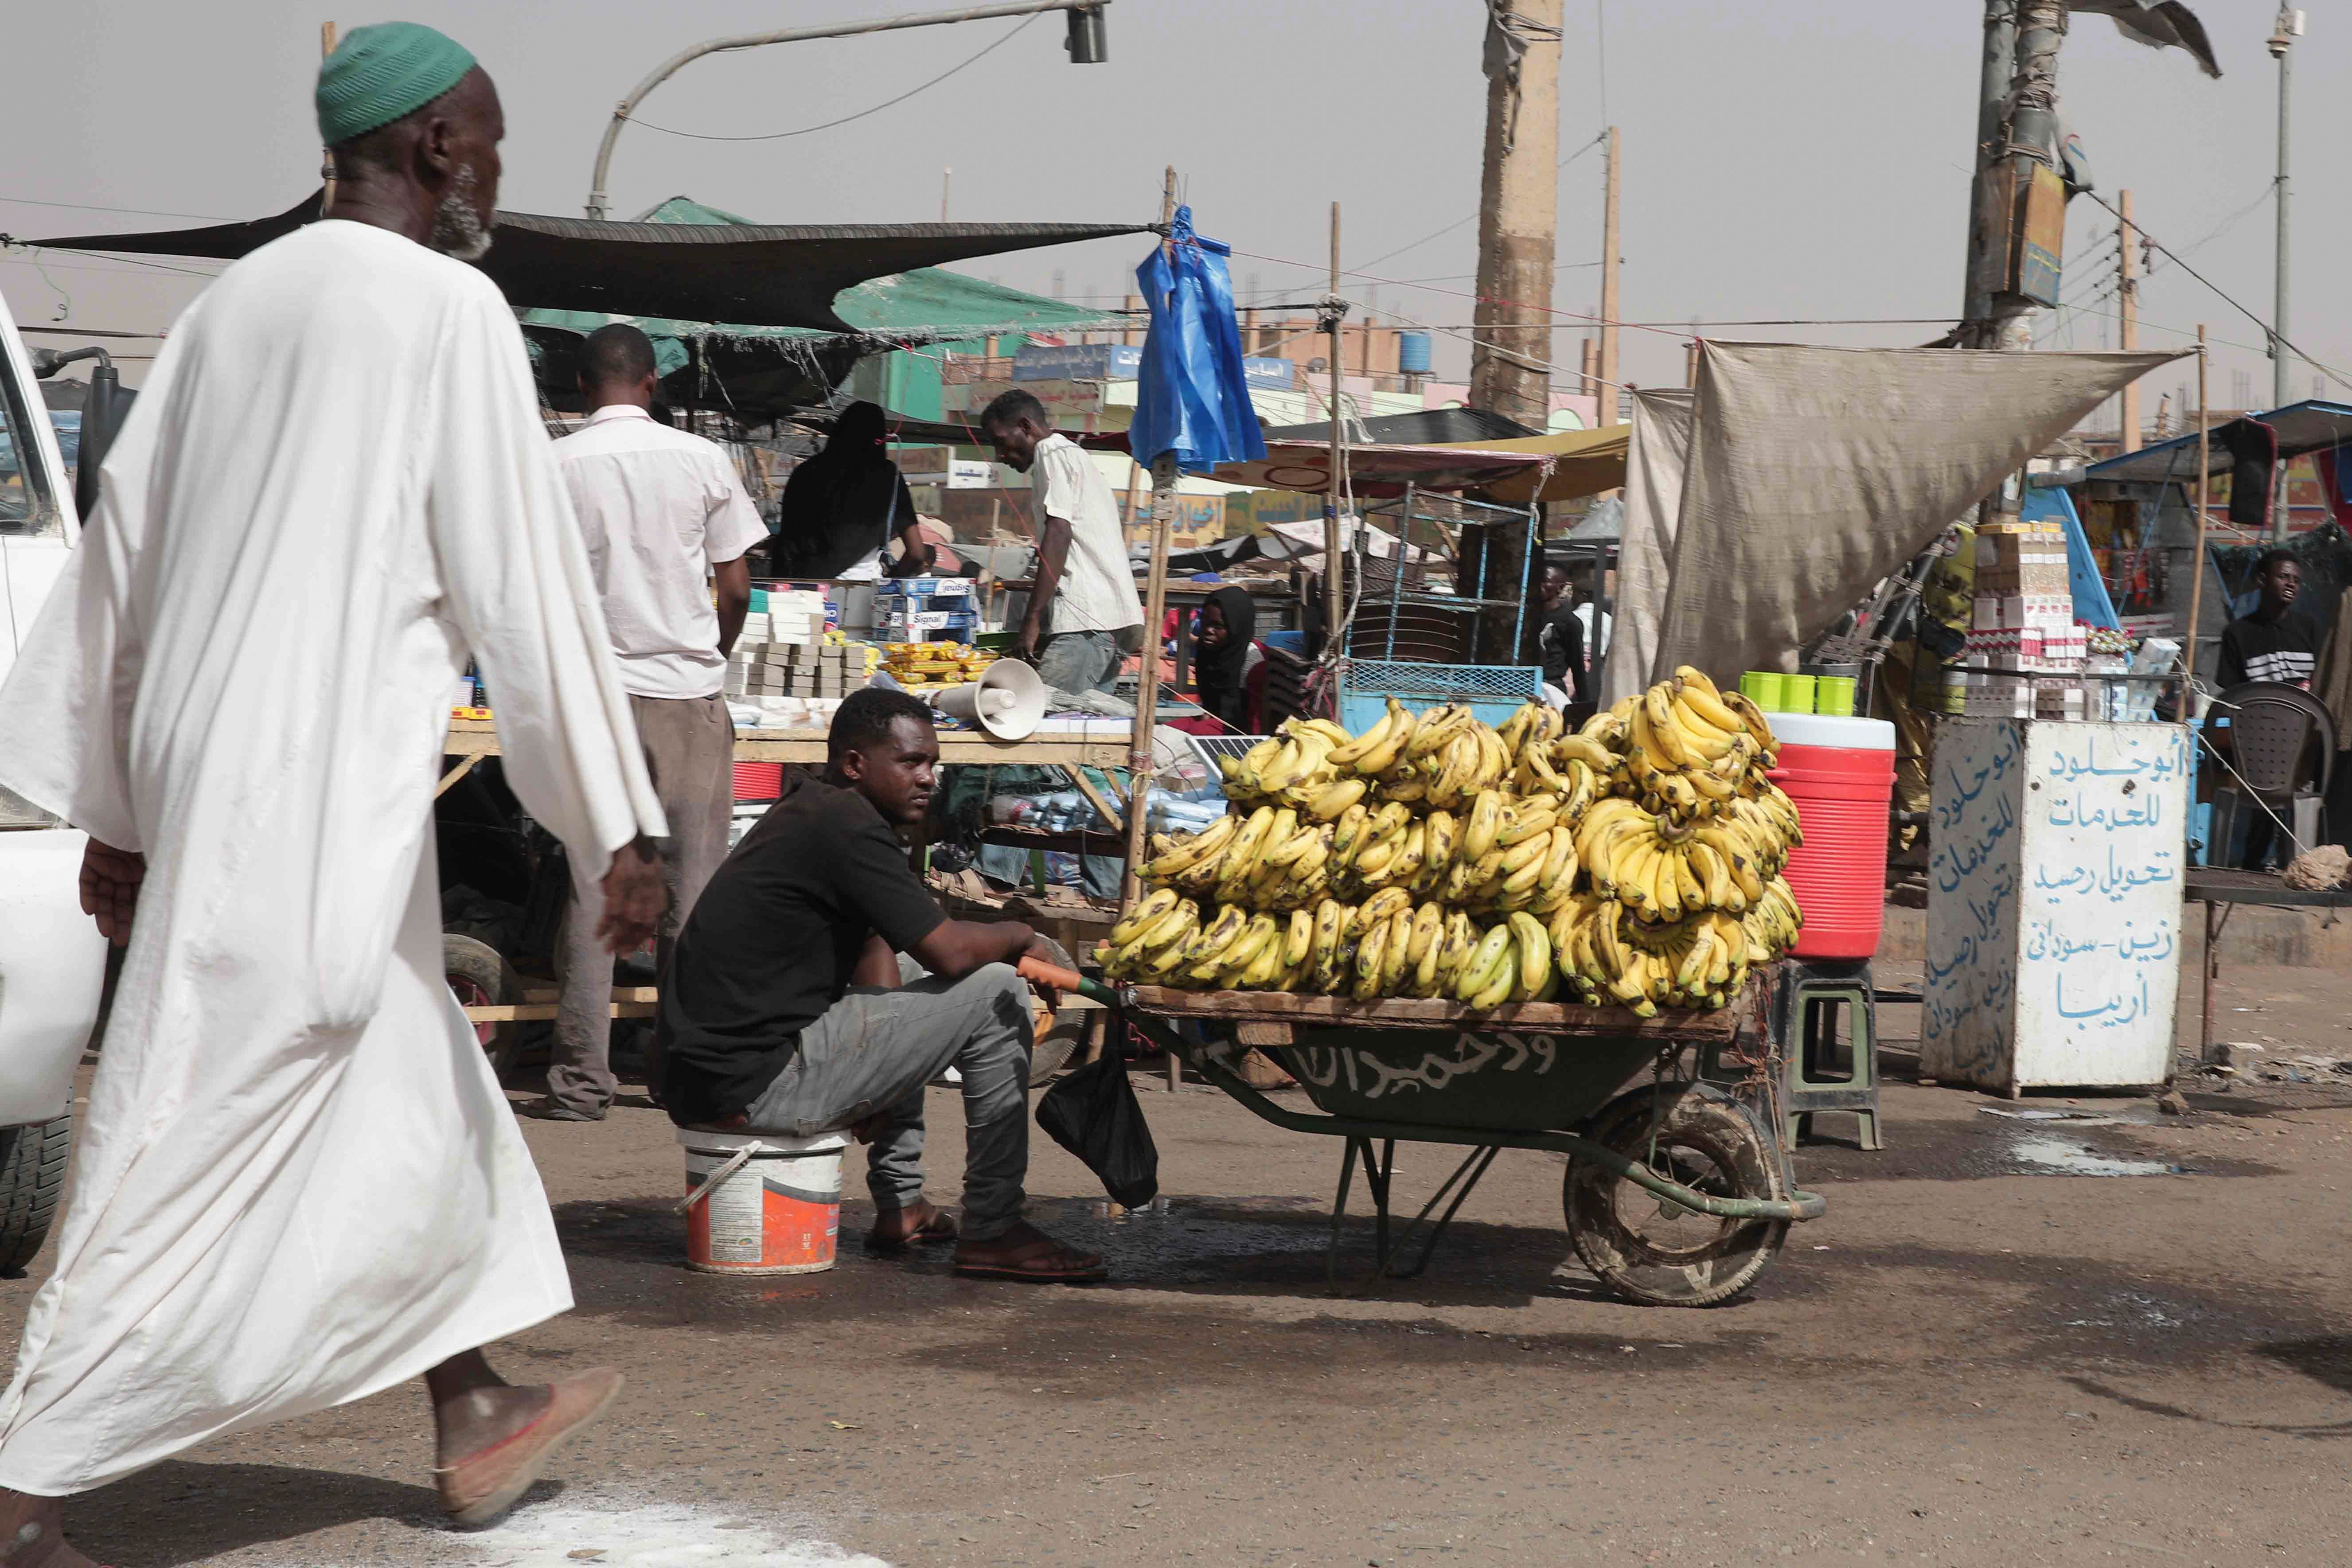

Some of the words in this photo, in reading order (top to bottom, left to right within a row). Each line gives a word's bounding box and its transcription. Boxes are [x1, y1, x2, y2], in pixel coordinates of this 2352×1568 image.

[913, 614, 941, 624] Signal
[2049, 736, 2150, 782] خلود
[2049, 791, 2160, 831] للخدمات
[1933, 791, 2014, 892] للخدمات
[2034, 864, 2095, 904] رصيد
[2099, 844, 2173, 902] تحويل
[2119, 919, 2173, 961] زين
